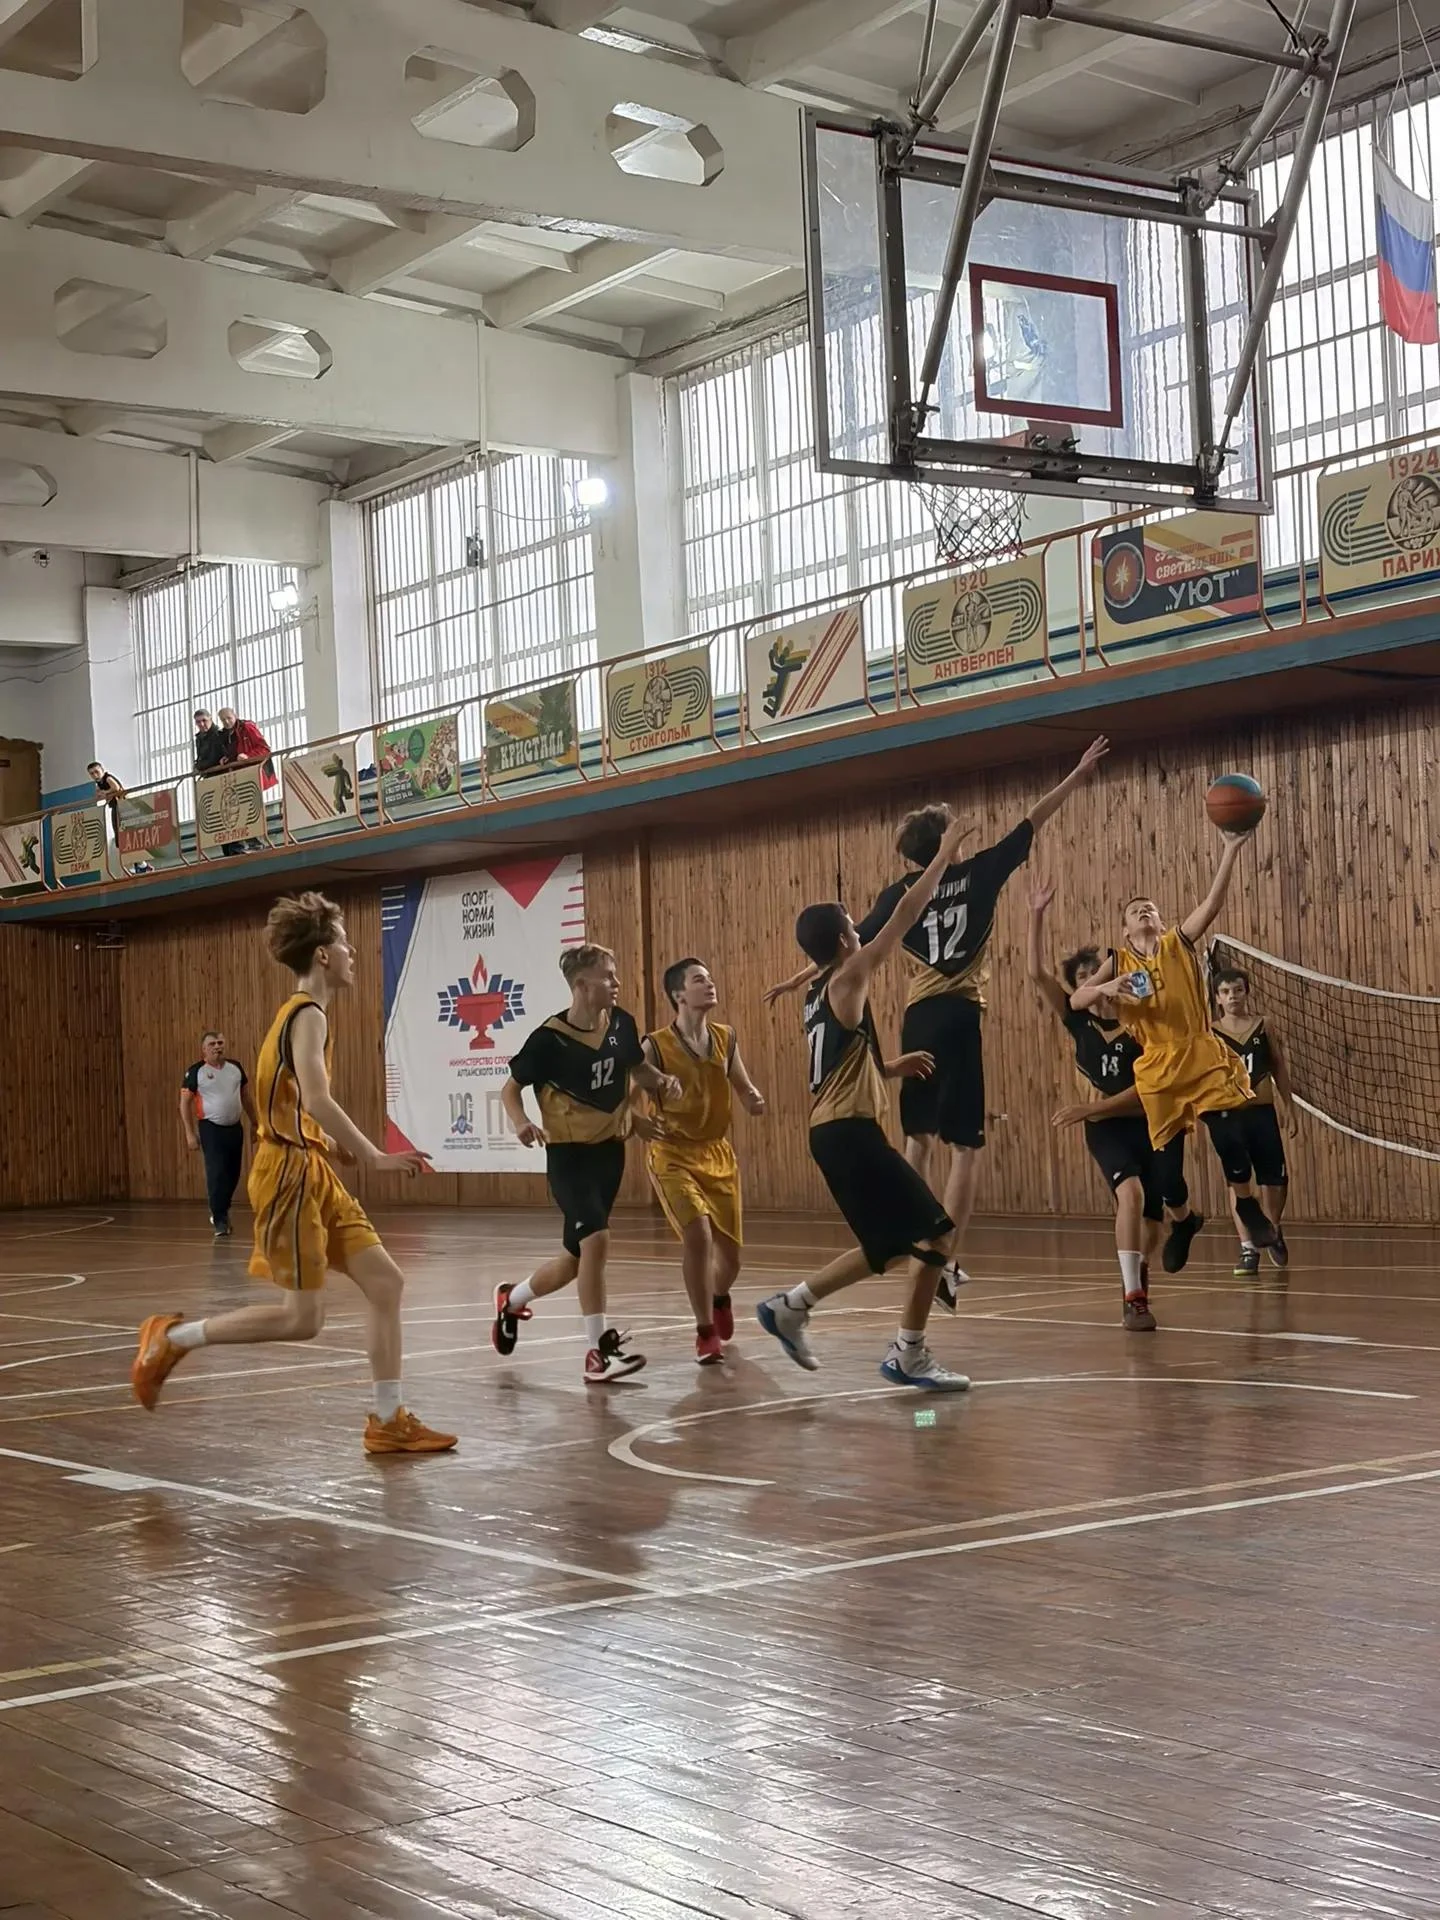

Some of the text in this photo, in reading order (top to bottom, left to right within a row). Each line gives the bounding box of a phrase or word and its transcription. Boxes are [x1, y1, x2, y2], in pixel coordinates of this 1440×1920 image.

[1388, 447, 1439, 480] 1924
[954, 570, 988, 595] 1920
[645, 658, 668, 679] 1912
[935, 646, 1014, 680] АНТВЕРПЕН
[500, 730, 564, 770] КРИСТАЛЛ
[630, 724, 691, 751] СТОКГОЛЬМ
[462, 905, 494, 924] НОРМА
[463, 922, 495, 940] ЖИЗНИ
[923, 904, 967, 965] 12
[608, 1036, 618, 1046] R
[495, 1055, 512, 1065] СПОР
[1101, 1053, 1120, 1077] 14
[591, 1056, 615, 1090] 32
